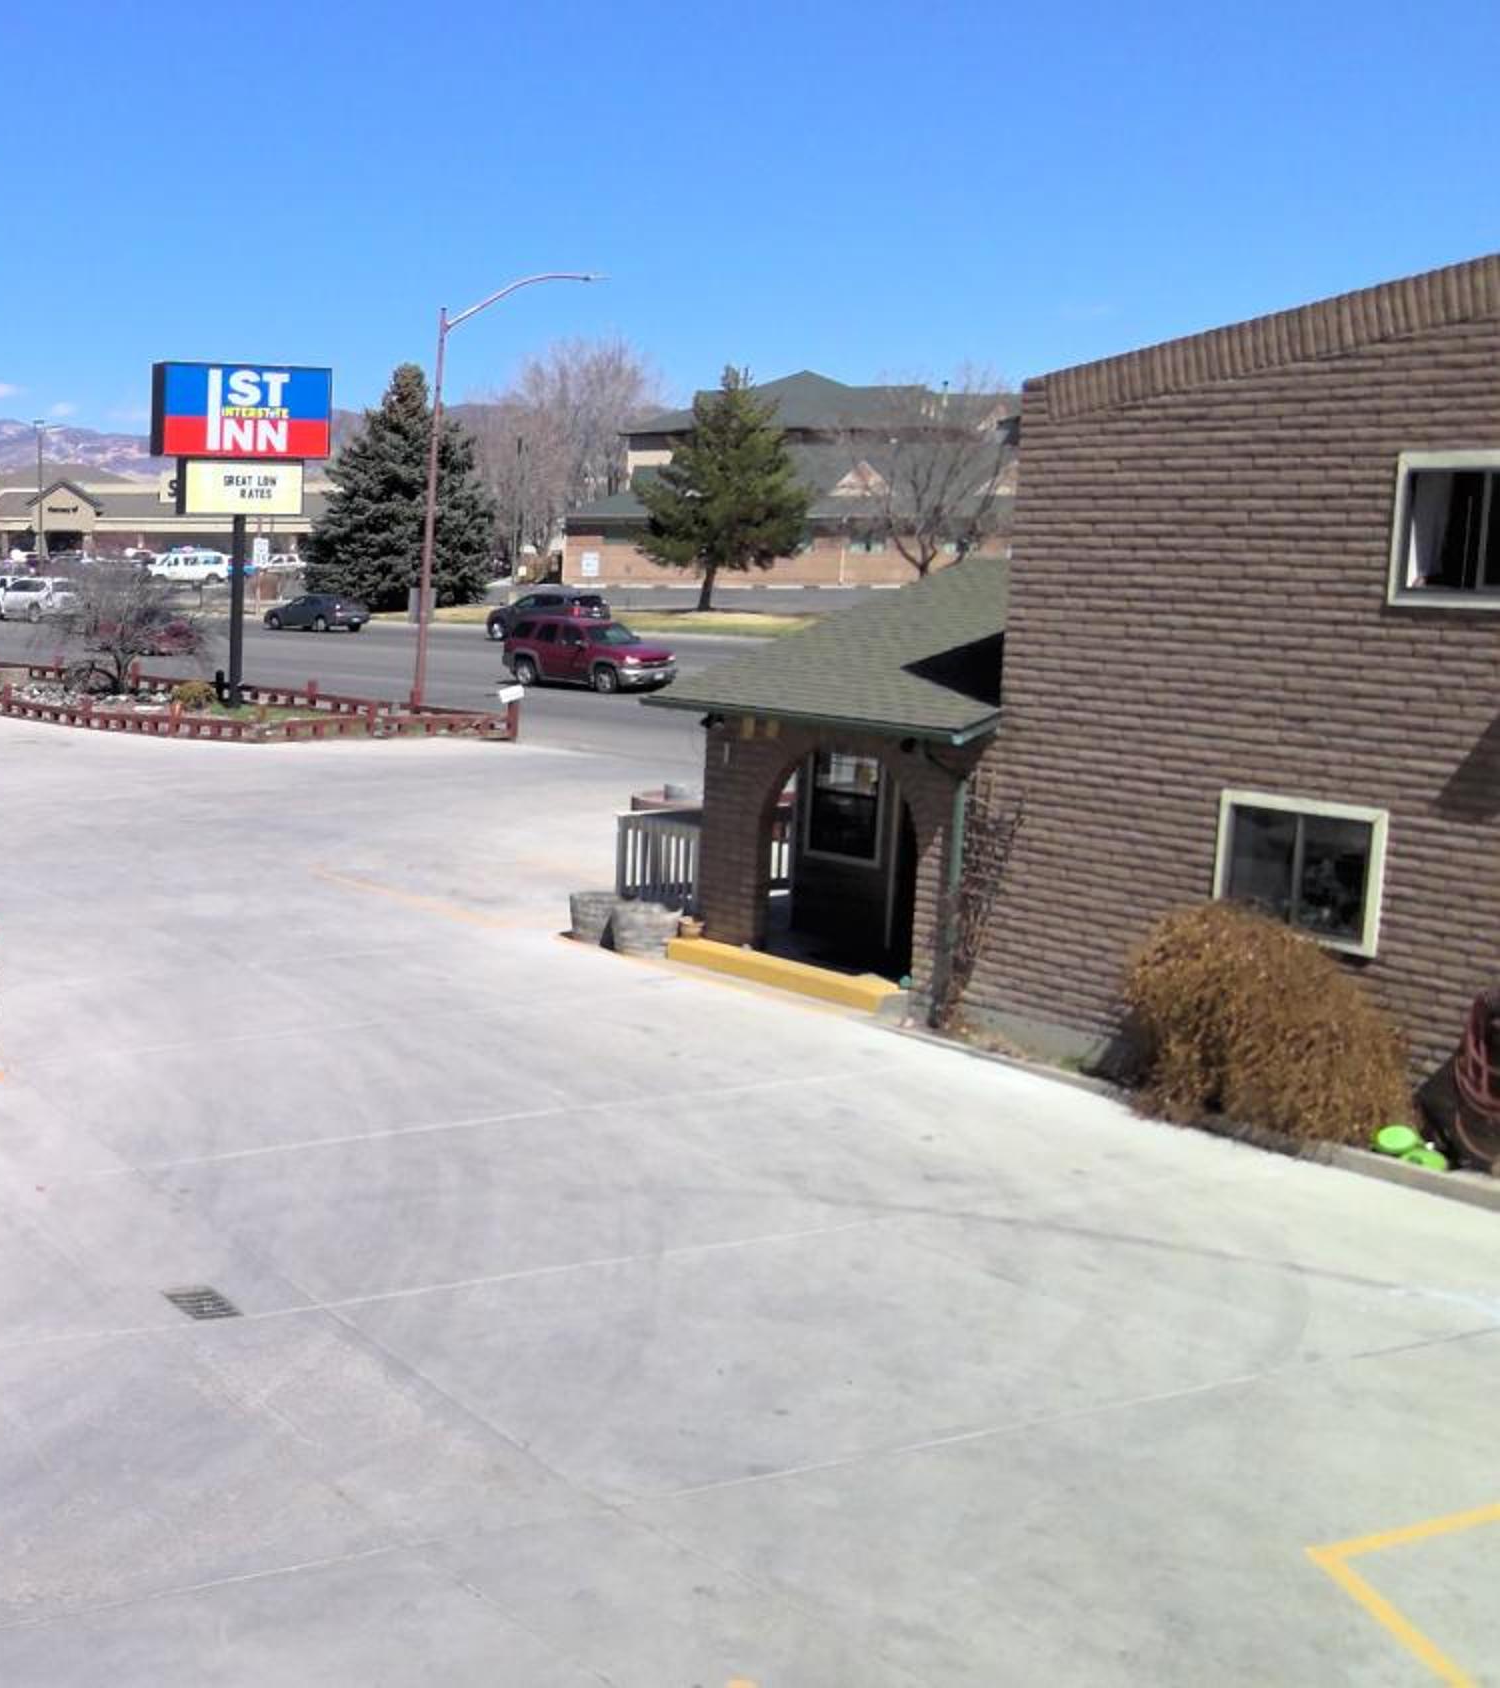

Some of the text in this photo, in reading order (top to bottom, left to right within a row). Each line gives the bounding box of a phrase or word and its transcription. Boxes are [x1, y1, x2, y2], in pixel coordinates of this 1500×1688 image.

[206, 410, 289, 452] INN
[224, 475, 277, 486] GREAT LOW
[240, 488, 272, 499] RATES
